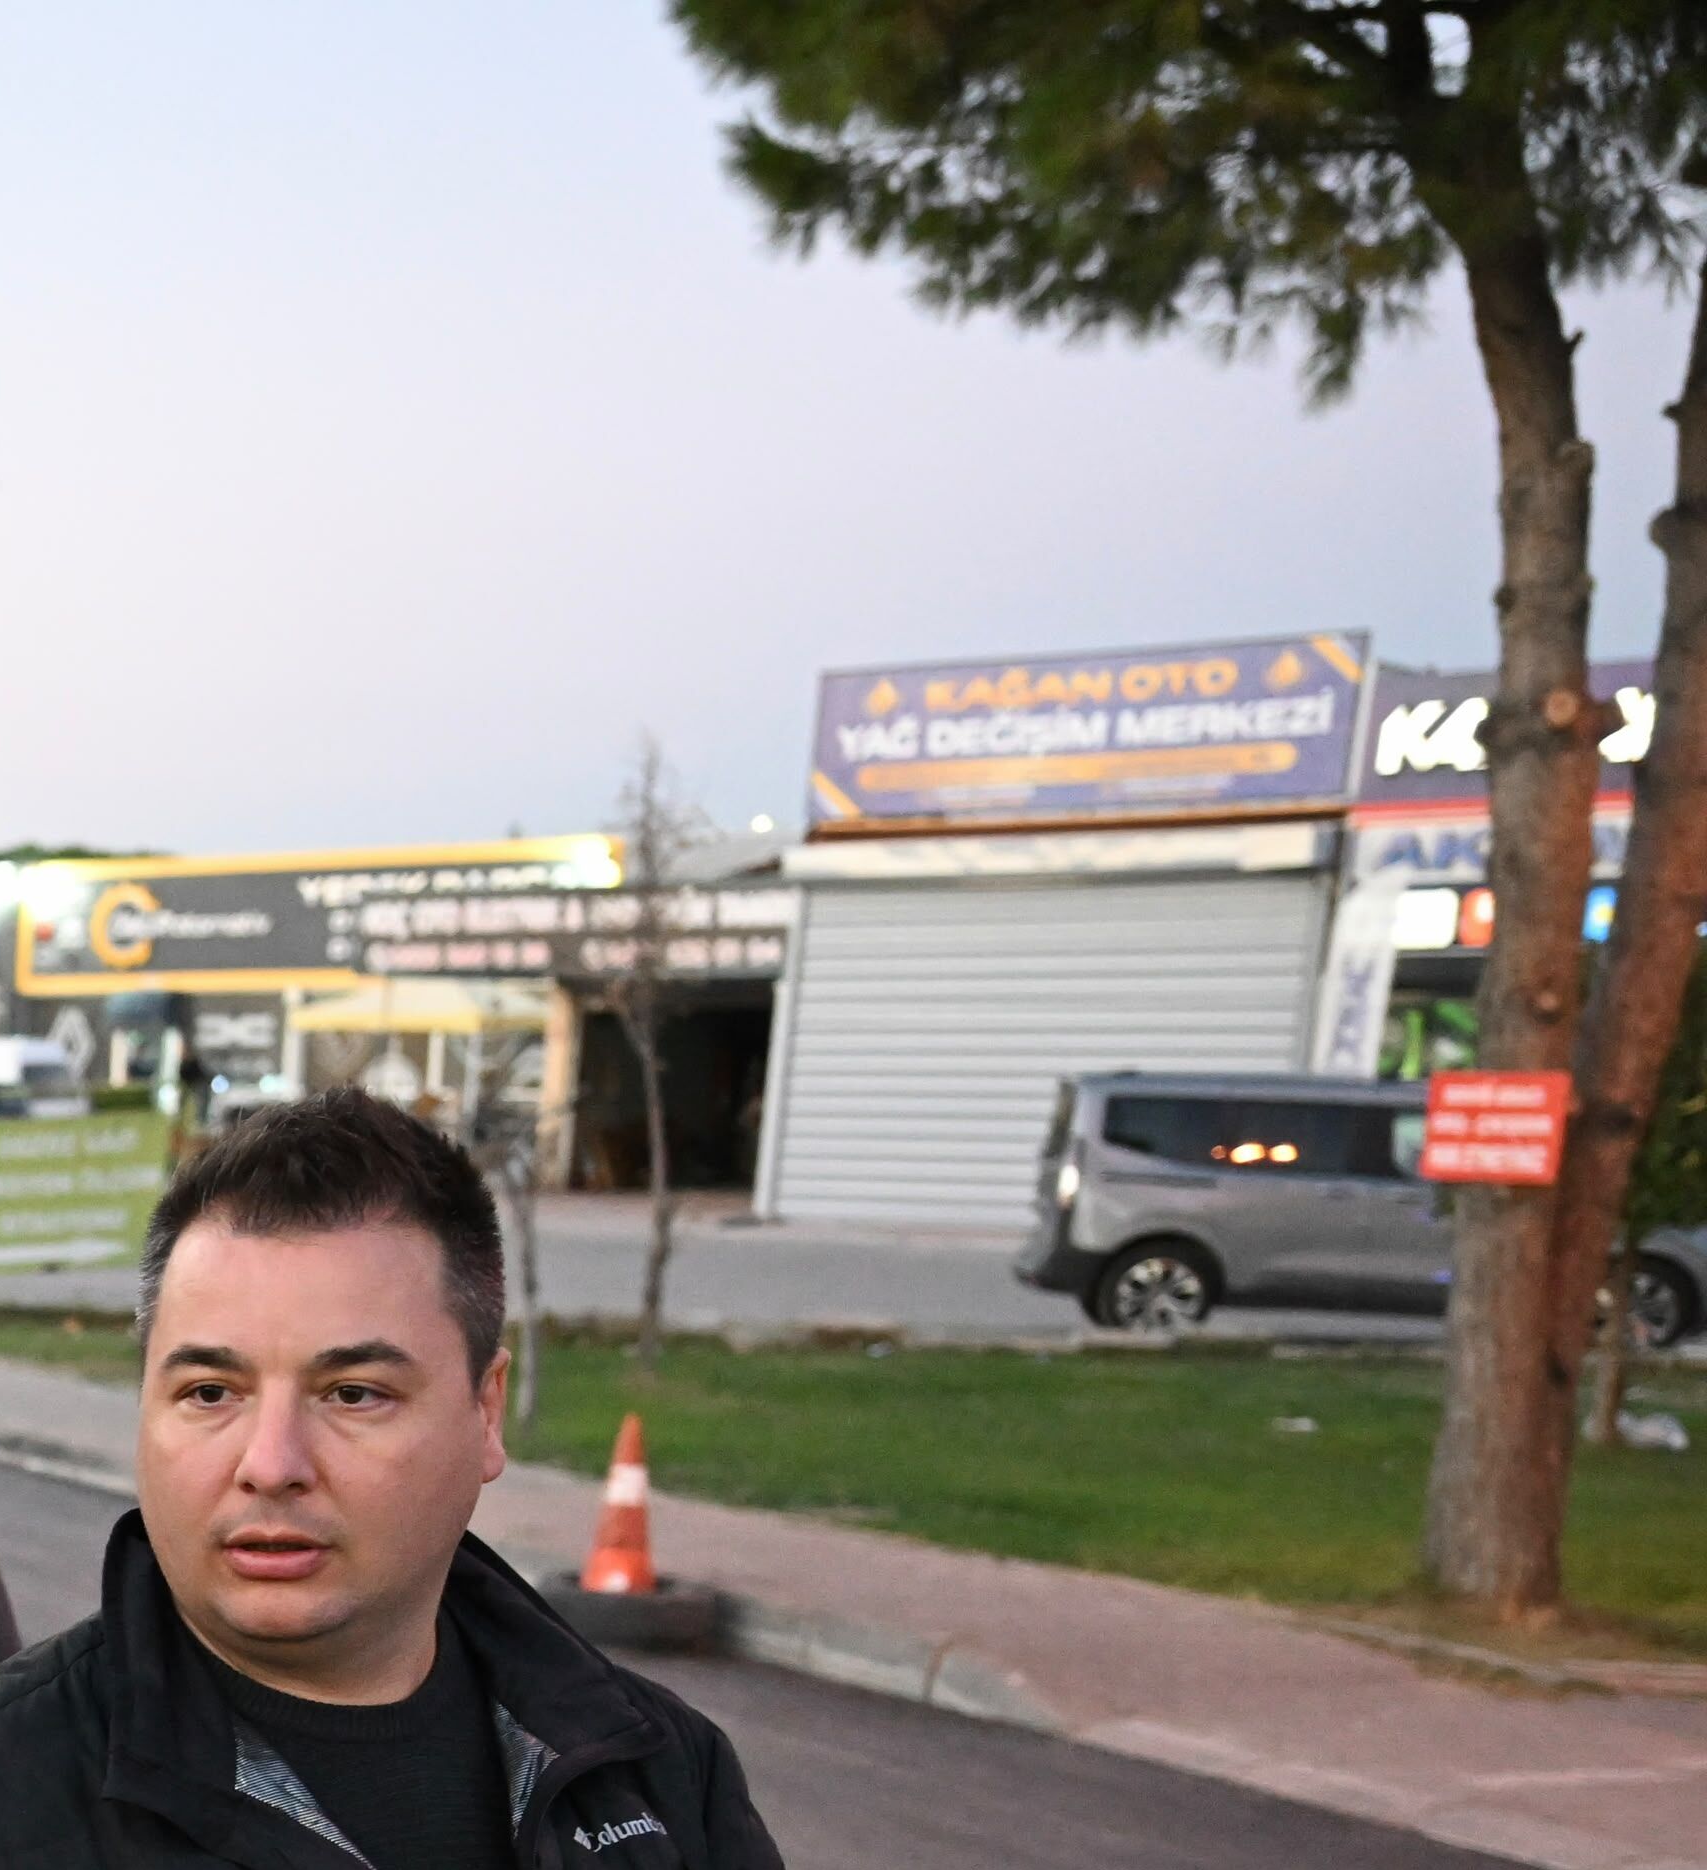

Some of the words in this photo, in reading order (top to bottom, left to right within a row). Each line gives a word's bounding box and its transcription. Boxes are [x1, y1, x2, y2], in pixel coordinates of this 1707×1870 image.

[1119, 659, 1239, 701] OTO
[837, 712, 922, 762] YAĞ
[1115, 685, 1335, 750] MERKEZİ
